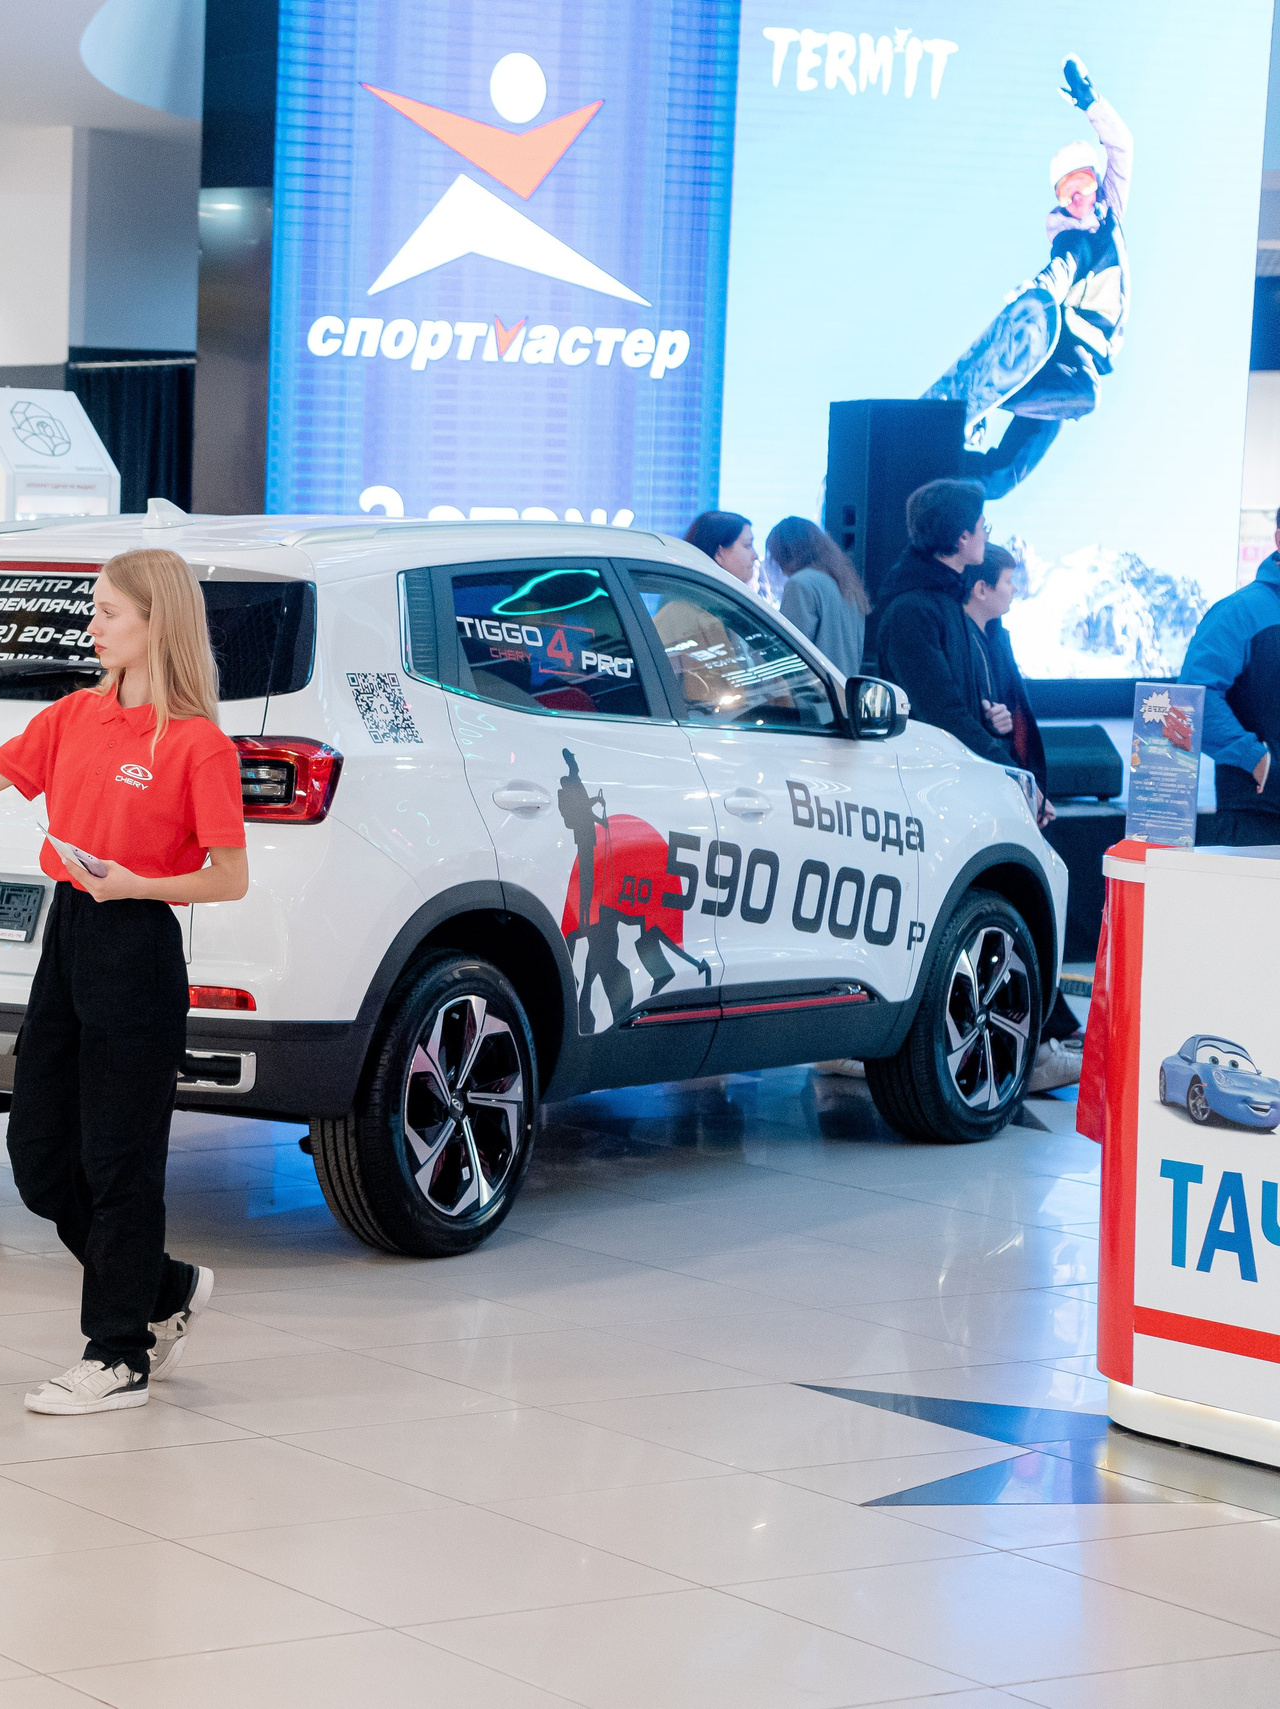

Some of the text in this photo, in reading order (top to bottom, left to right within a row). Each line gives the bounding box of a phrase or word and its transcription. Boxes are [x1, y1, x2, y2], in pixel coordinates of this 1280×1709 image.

[762, 27, 959, 99] TERMIT
[307, 315, 691, 379] спортмастер
[0, 579, 72, 595] ЦЕНТР
[455, 616, 543, 647] TIGGO
[546, 629, 574, 667] 4
[581, 650, 632, 679] PRO
[490, 647, 532, 663] CHERY
[115, 775, 149, 790] CHERY
[785, 780, 925, 856] Выгода
[618, 875, 653, 907] до
[661, 830, 780, 925] 590
[792, 859, 902, 946] 000
